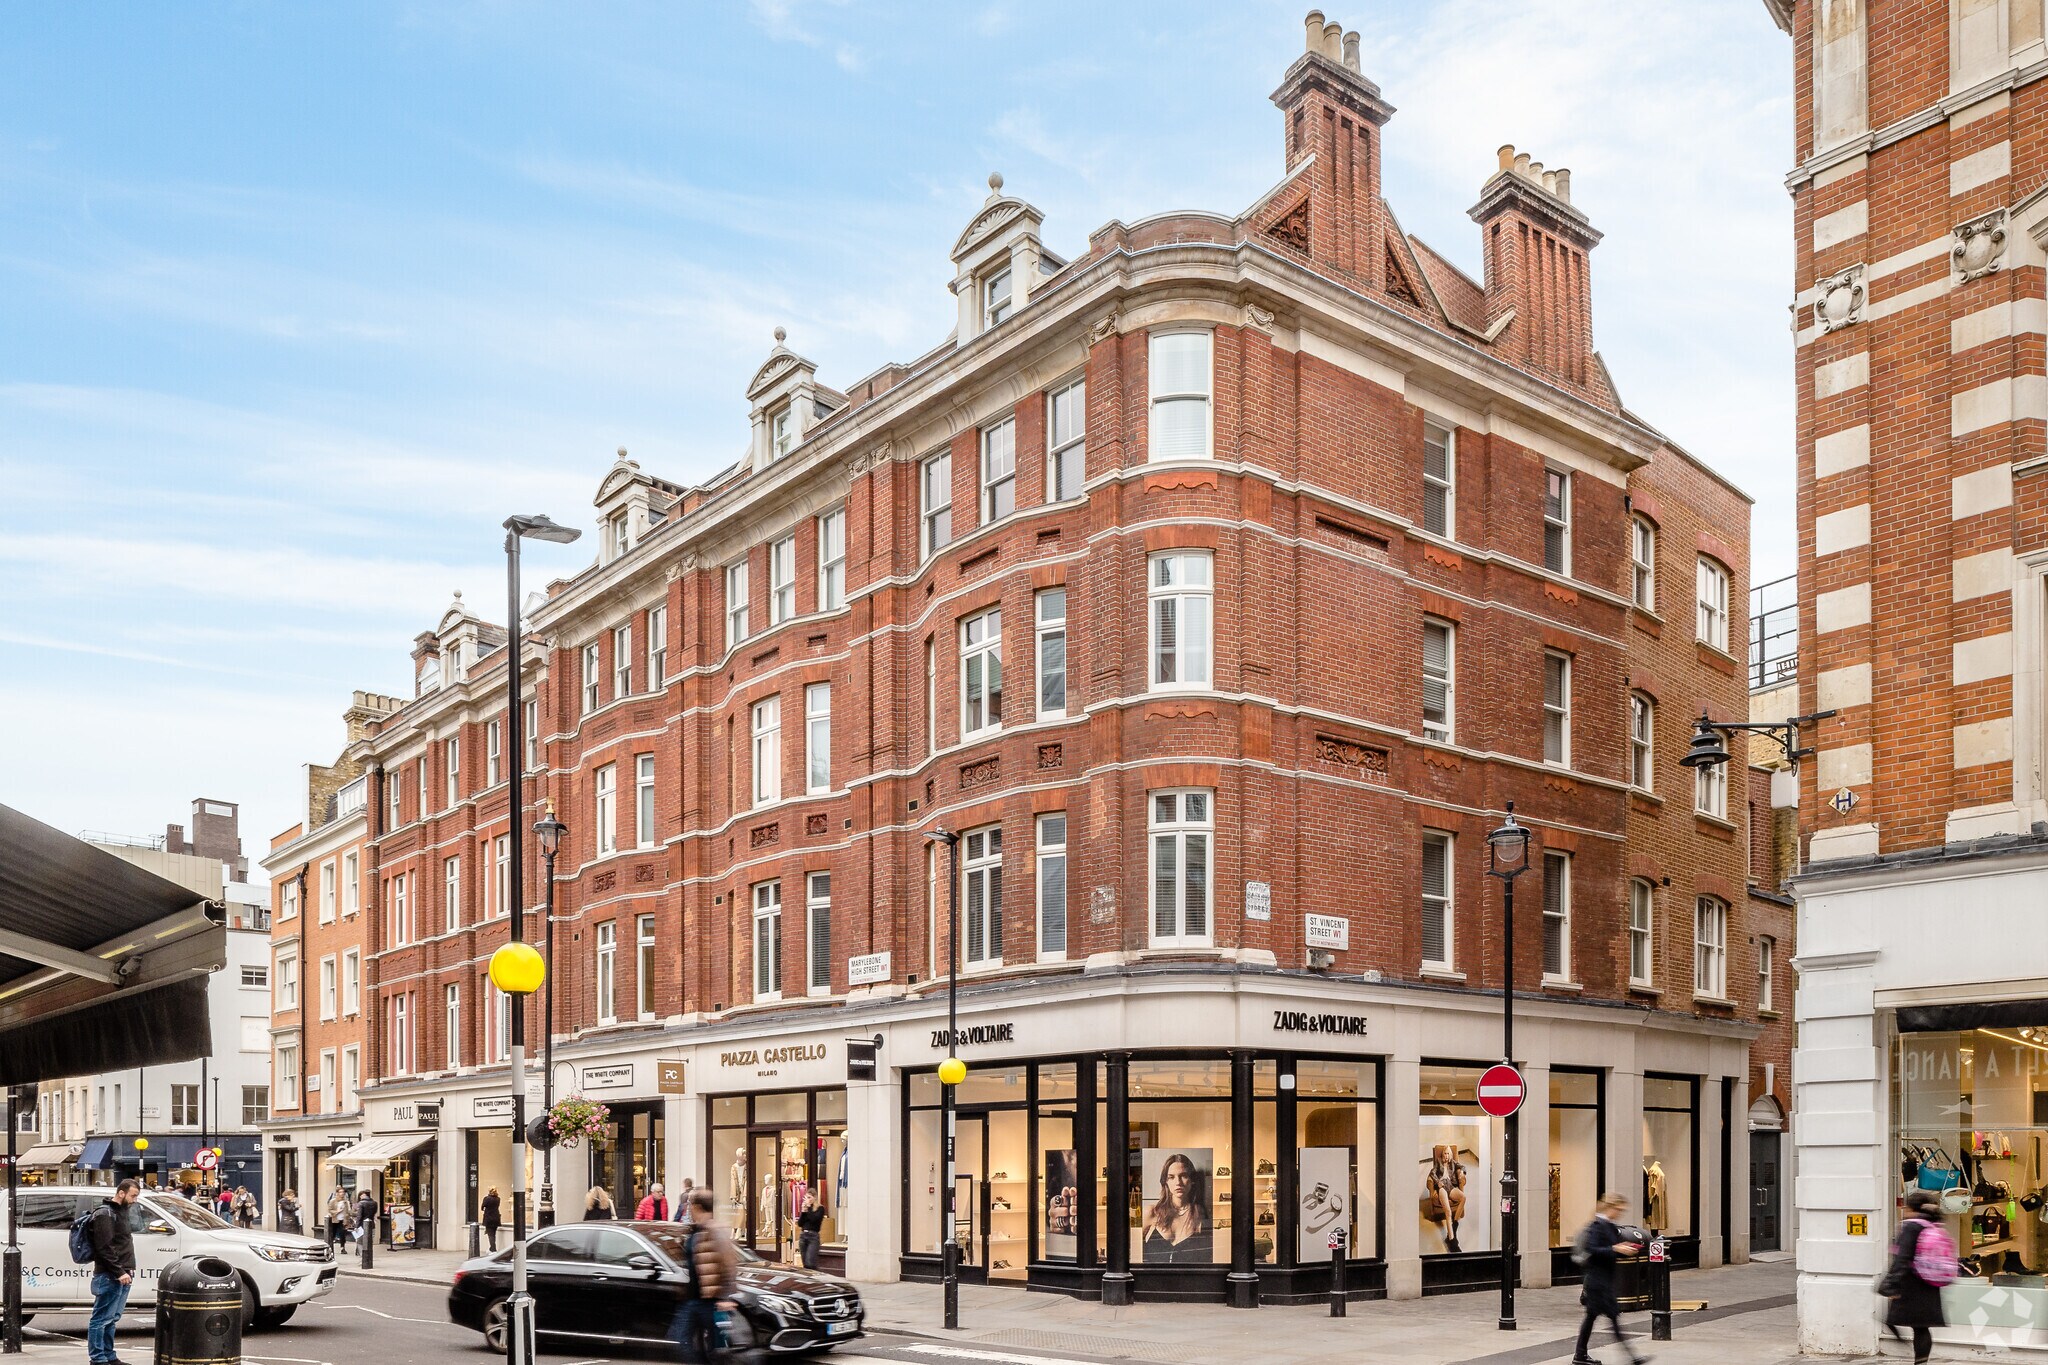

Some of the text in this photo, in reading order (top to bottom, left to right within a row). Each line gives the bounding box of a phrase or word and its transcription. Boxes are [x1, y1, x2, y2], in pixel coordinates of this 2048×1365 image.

[1836, 792, 1852, 809] H
[1320, 918, 1345, 929] VINCENT
[1310, 927, 1341, 938] STREET W1
[851, 956, 881, 967] MARYLEBONE
[863, 965, 880, 975] STREET
[721, 1044, 827, 1067] PIAZZA CASTELLO
[609, 1069, 630, 1077] COMPANY
[665, 1069, 678, 1080] PC
[393, 1107, 413, 1120] PAUL
